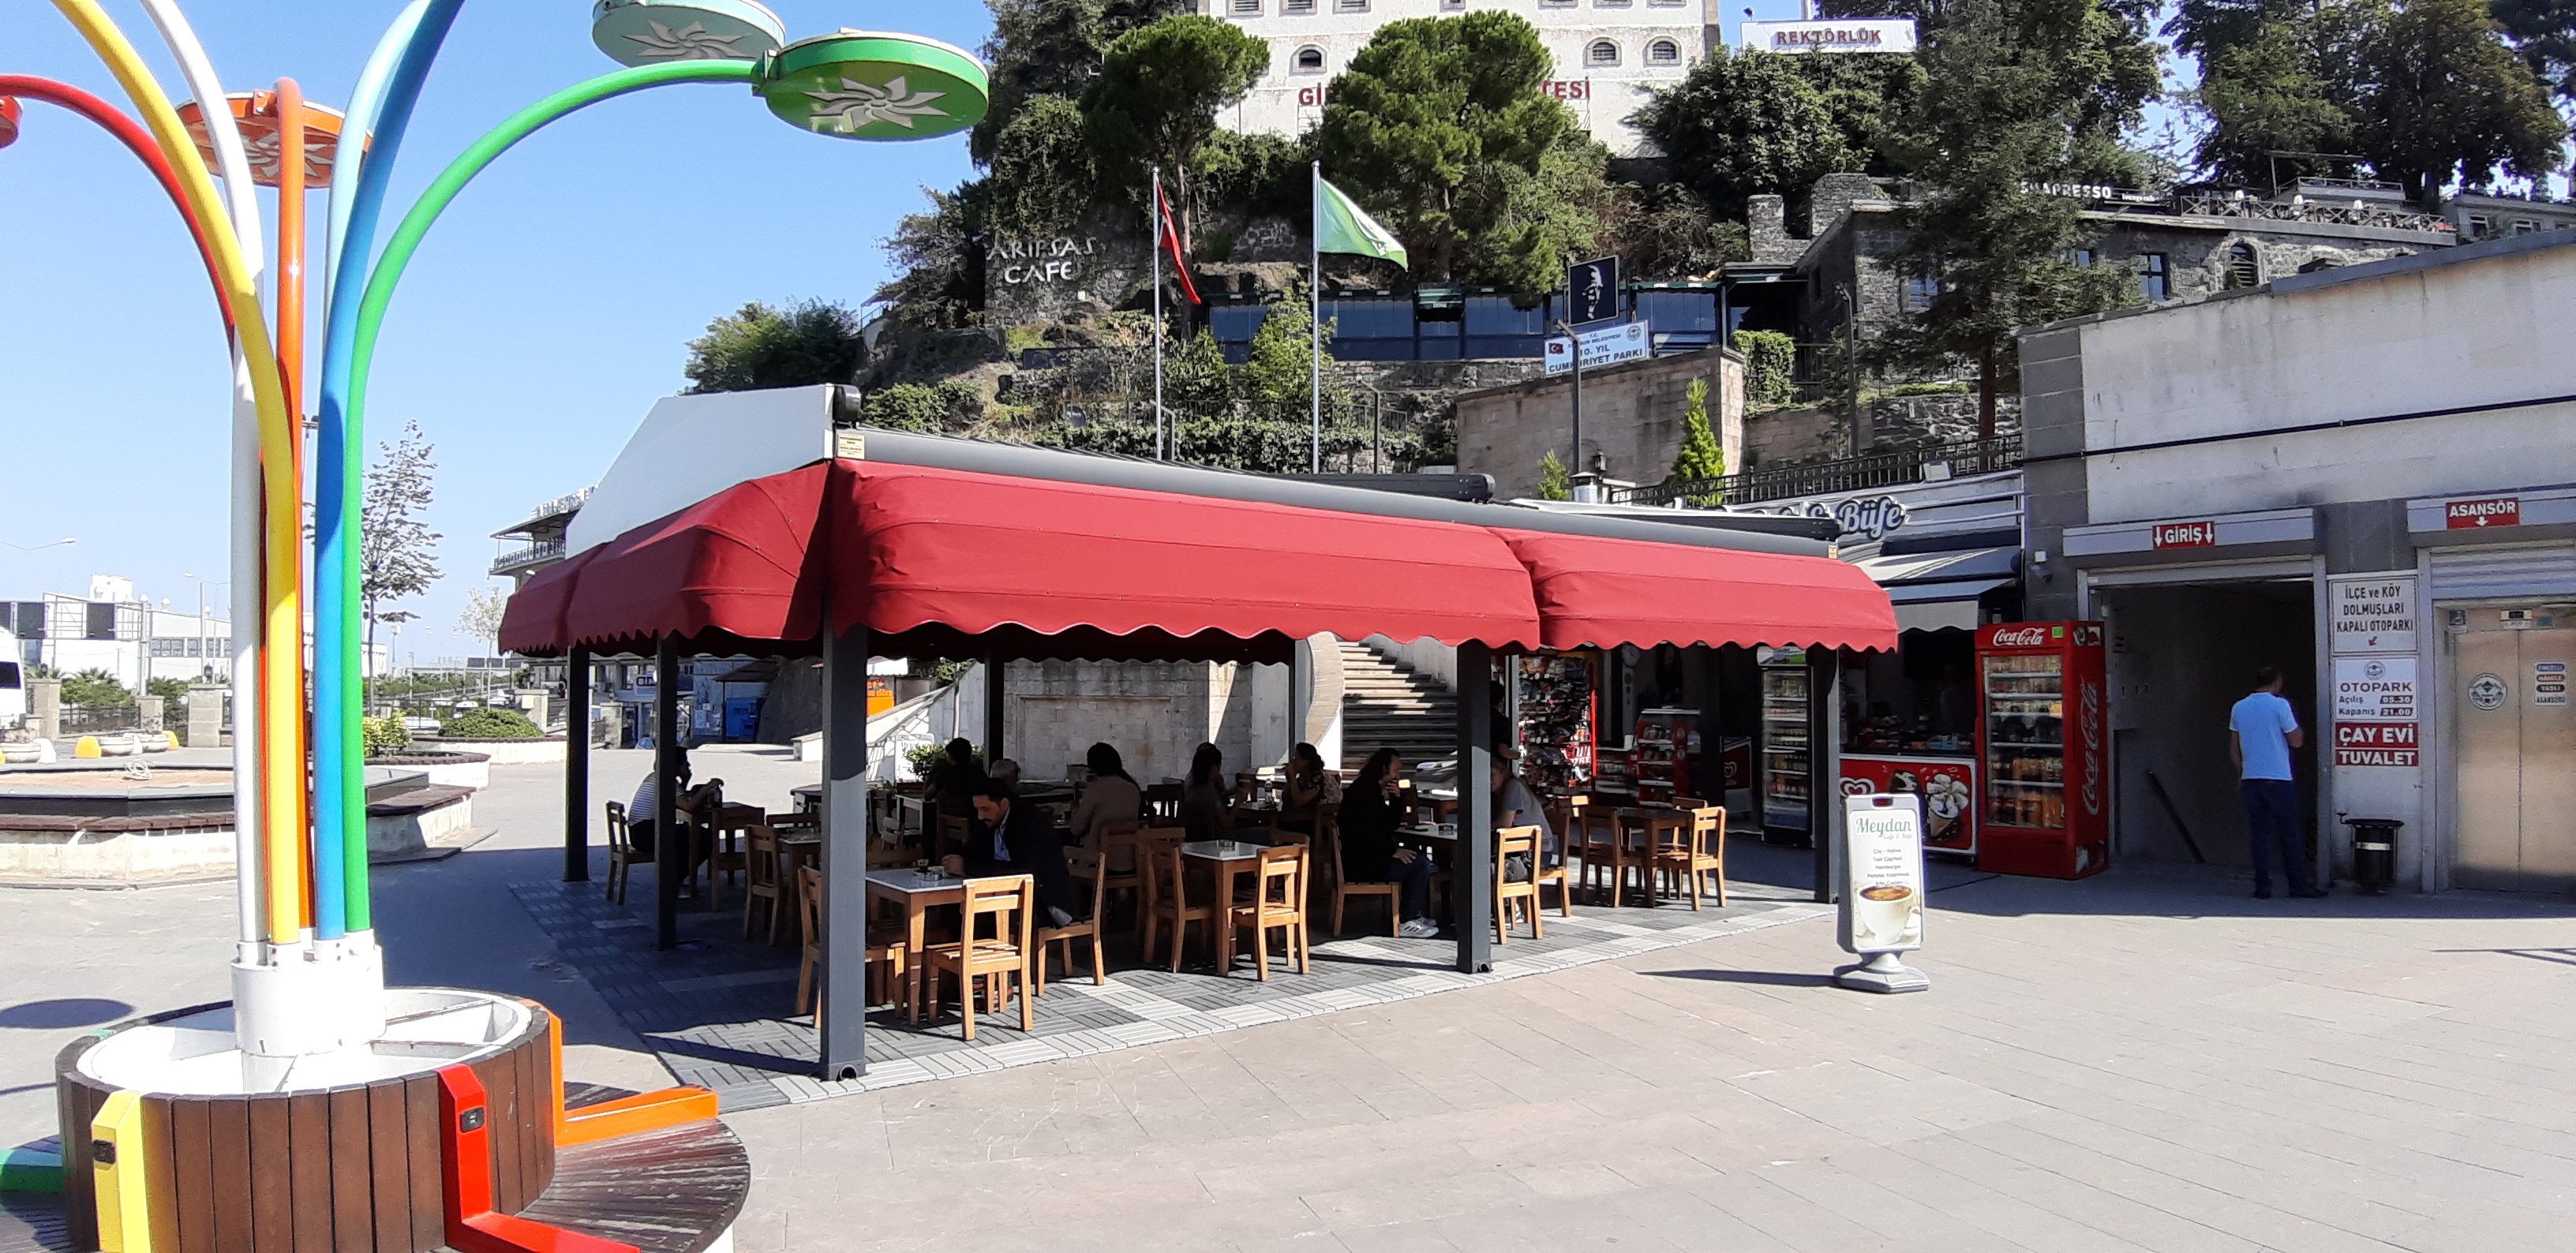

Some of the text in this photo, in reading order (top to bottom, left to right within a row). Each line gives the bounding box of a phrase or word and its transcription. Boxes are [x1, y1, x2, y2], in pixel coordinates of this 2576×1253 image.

[1777, 27, 1881, 43] REKTÖRLÜK
[1005, 261, 1072, 283] CAFE
[1613, 349, 1643, 361] PARKI
[2449, 499, 2516, 518] ASANSÖR
[1844, 497, 1902, 538] Büfe
[2165, 525, 2203, 544] GİRİŞ
[2345, 582, 2402, 600] İLÇE ve KÖY
[2343, 602, 2404, 616] DOLMUŞLARI
[2336, 619, 2413, 632] KAPALI OTOPARKI
[2340, 682, 2413, 693] OTOPARK
[2338, 695, 2364, 705] Açılış
[2338, 707, 2376, 716] Kapanış
[2339, 723, 2414, 746] ÇAY EVİ
[2338, 750, 2416, 765] TUVALET
[1855, 817, 1911, 837] Meydan
